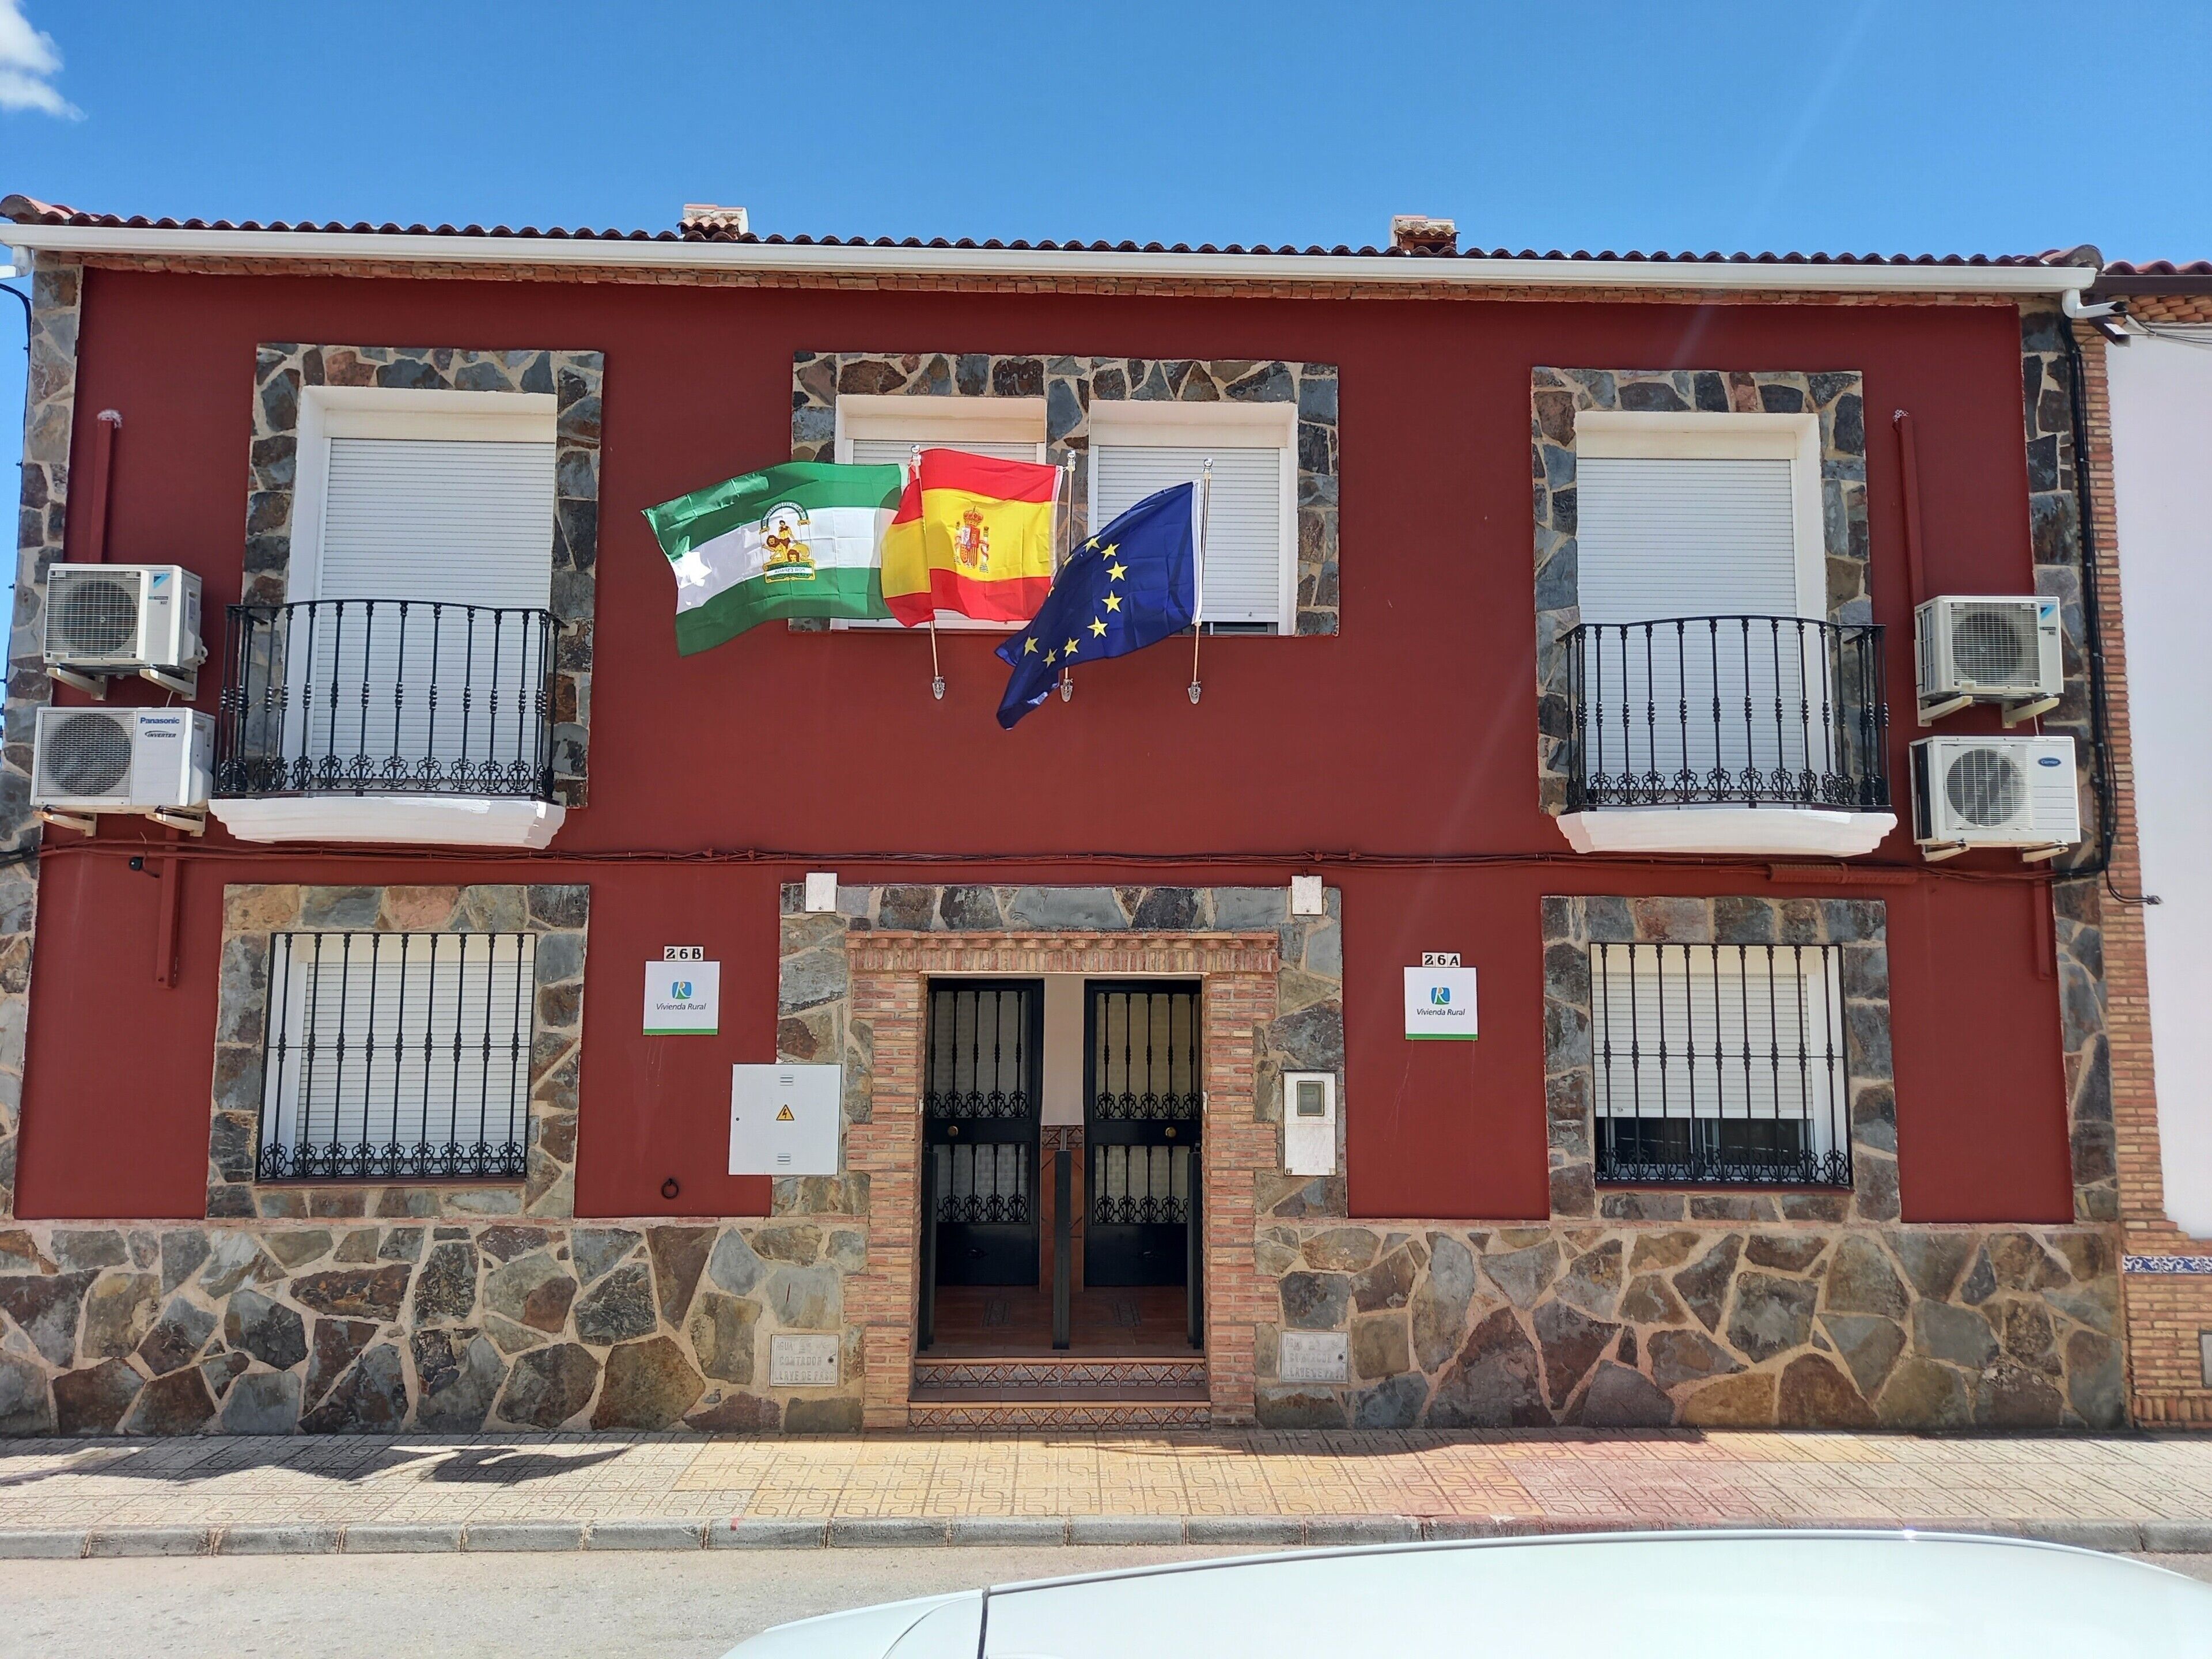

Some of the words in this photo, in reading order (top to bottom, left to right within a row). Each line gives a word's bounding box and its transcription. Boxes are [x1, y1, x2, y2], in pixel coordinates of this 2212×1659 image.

[666, 948, 701, 959] 26B
[1425, 955, 1459, 965] 26A
[776, 1341, 793, 1351] AGUA
[779, 1356, 822, 1366] CONTADOR
[774, 1370, 799, 1381] LLAVE
[801, 1370, 811, 1381] DE
[813, 1370, 834, 1381] PASO
